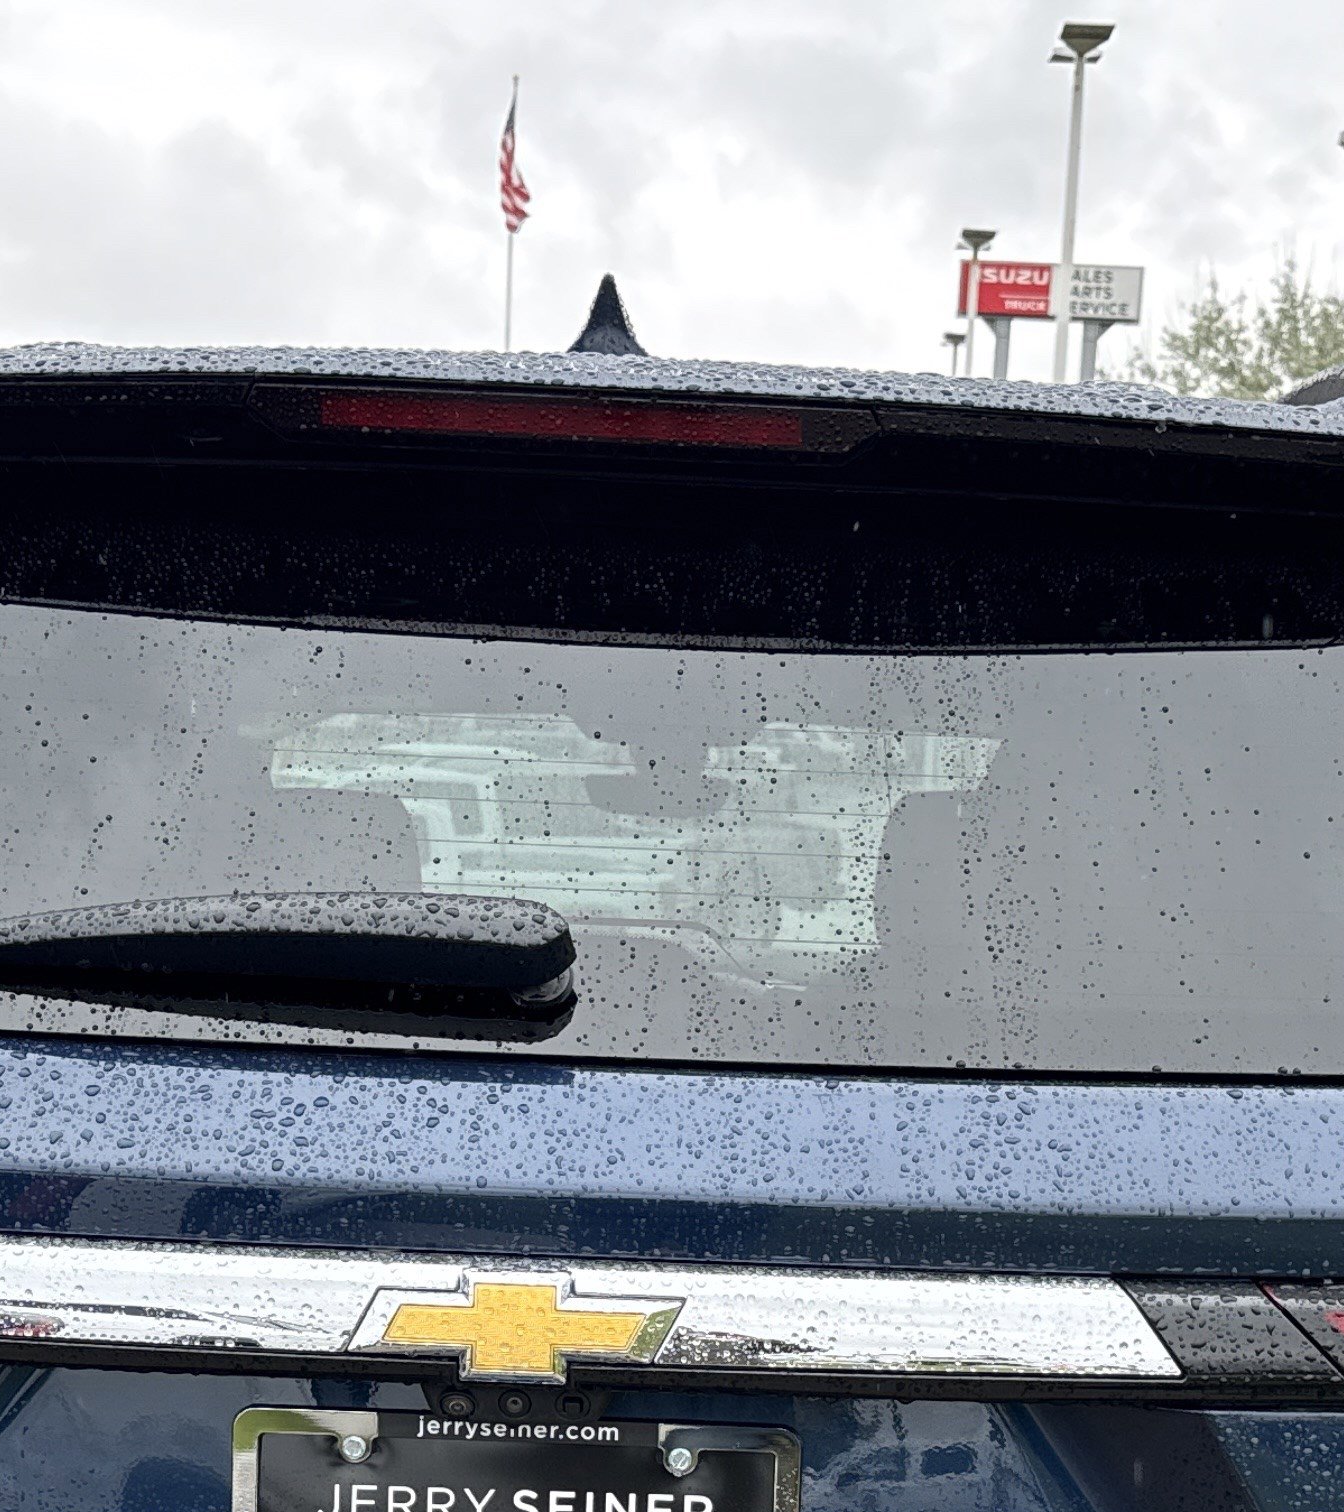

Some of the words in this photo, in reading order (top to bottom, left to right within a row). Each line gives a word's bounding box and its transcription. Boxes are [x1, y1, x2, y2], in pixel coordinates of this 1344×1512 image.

[1070, 269, 1114, 284] ALES
[1070, 285, 1114, 299] ARTS
[1069, 302, 1130, 316] ERVICE
[416, 1415, 620, 1442] jerryseiner.com
